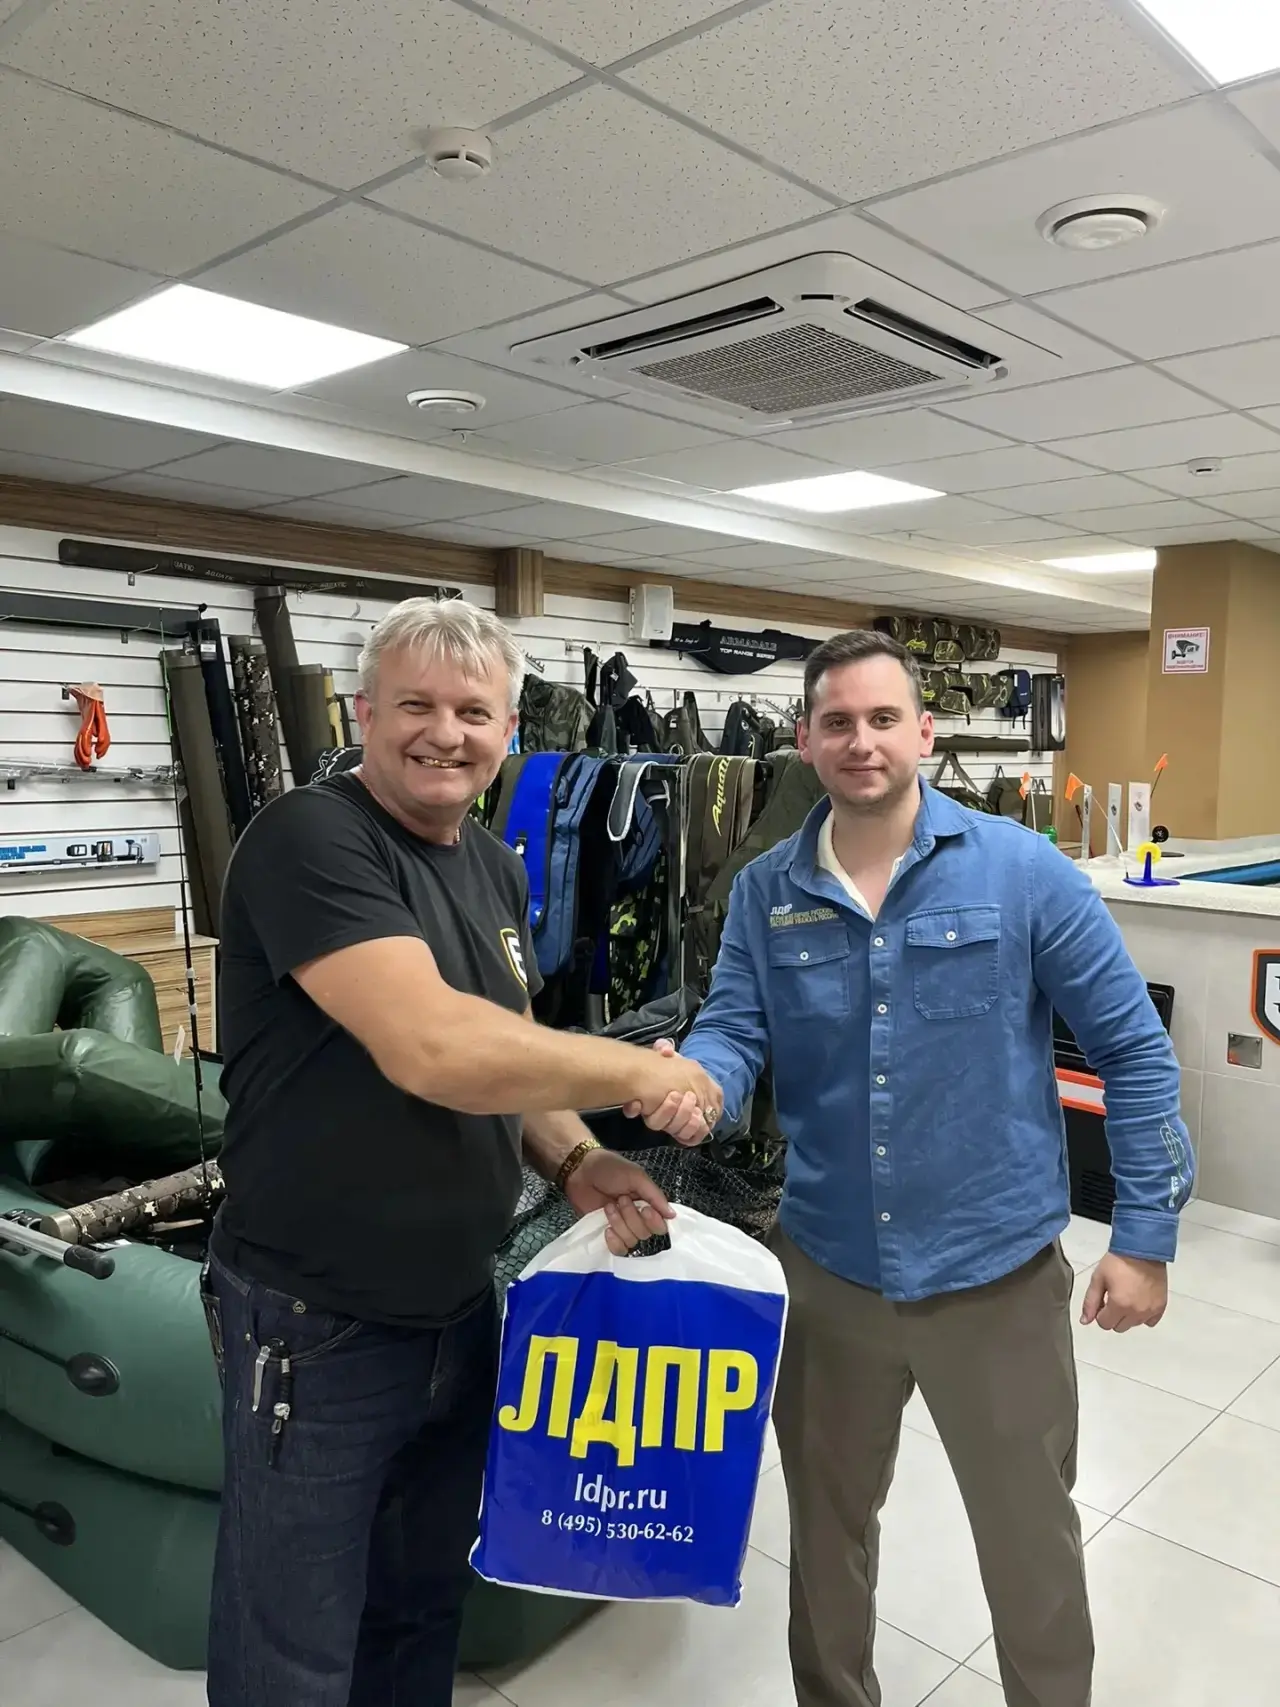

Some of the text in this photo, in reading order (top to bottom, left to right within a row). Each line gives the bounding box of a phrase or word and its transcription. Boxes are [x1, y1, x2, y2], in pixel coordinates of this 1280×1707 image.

[720, 635, 778, 652] ARMADALE
[733, 650, 754, 658] RANGE
[498, 1334, 759, 1468] ЛДПР
[574, 1473, 668, 1512] ldpr.ru
[541, 1509, 694, 1544] 8 (495) 530-62-62
